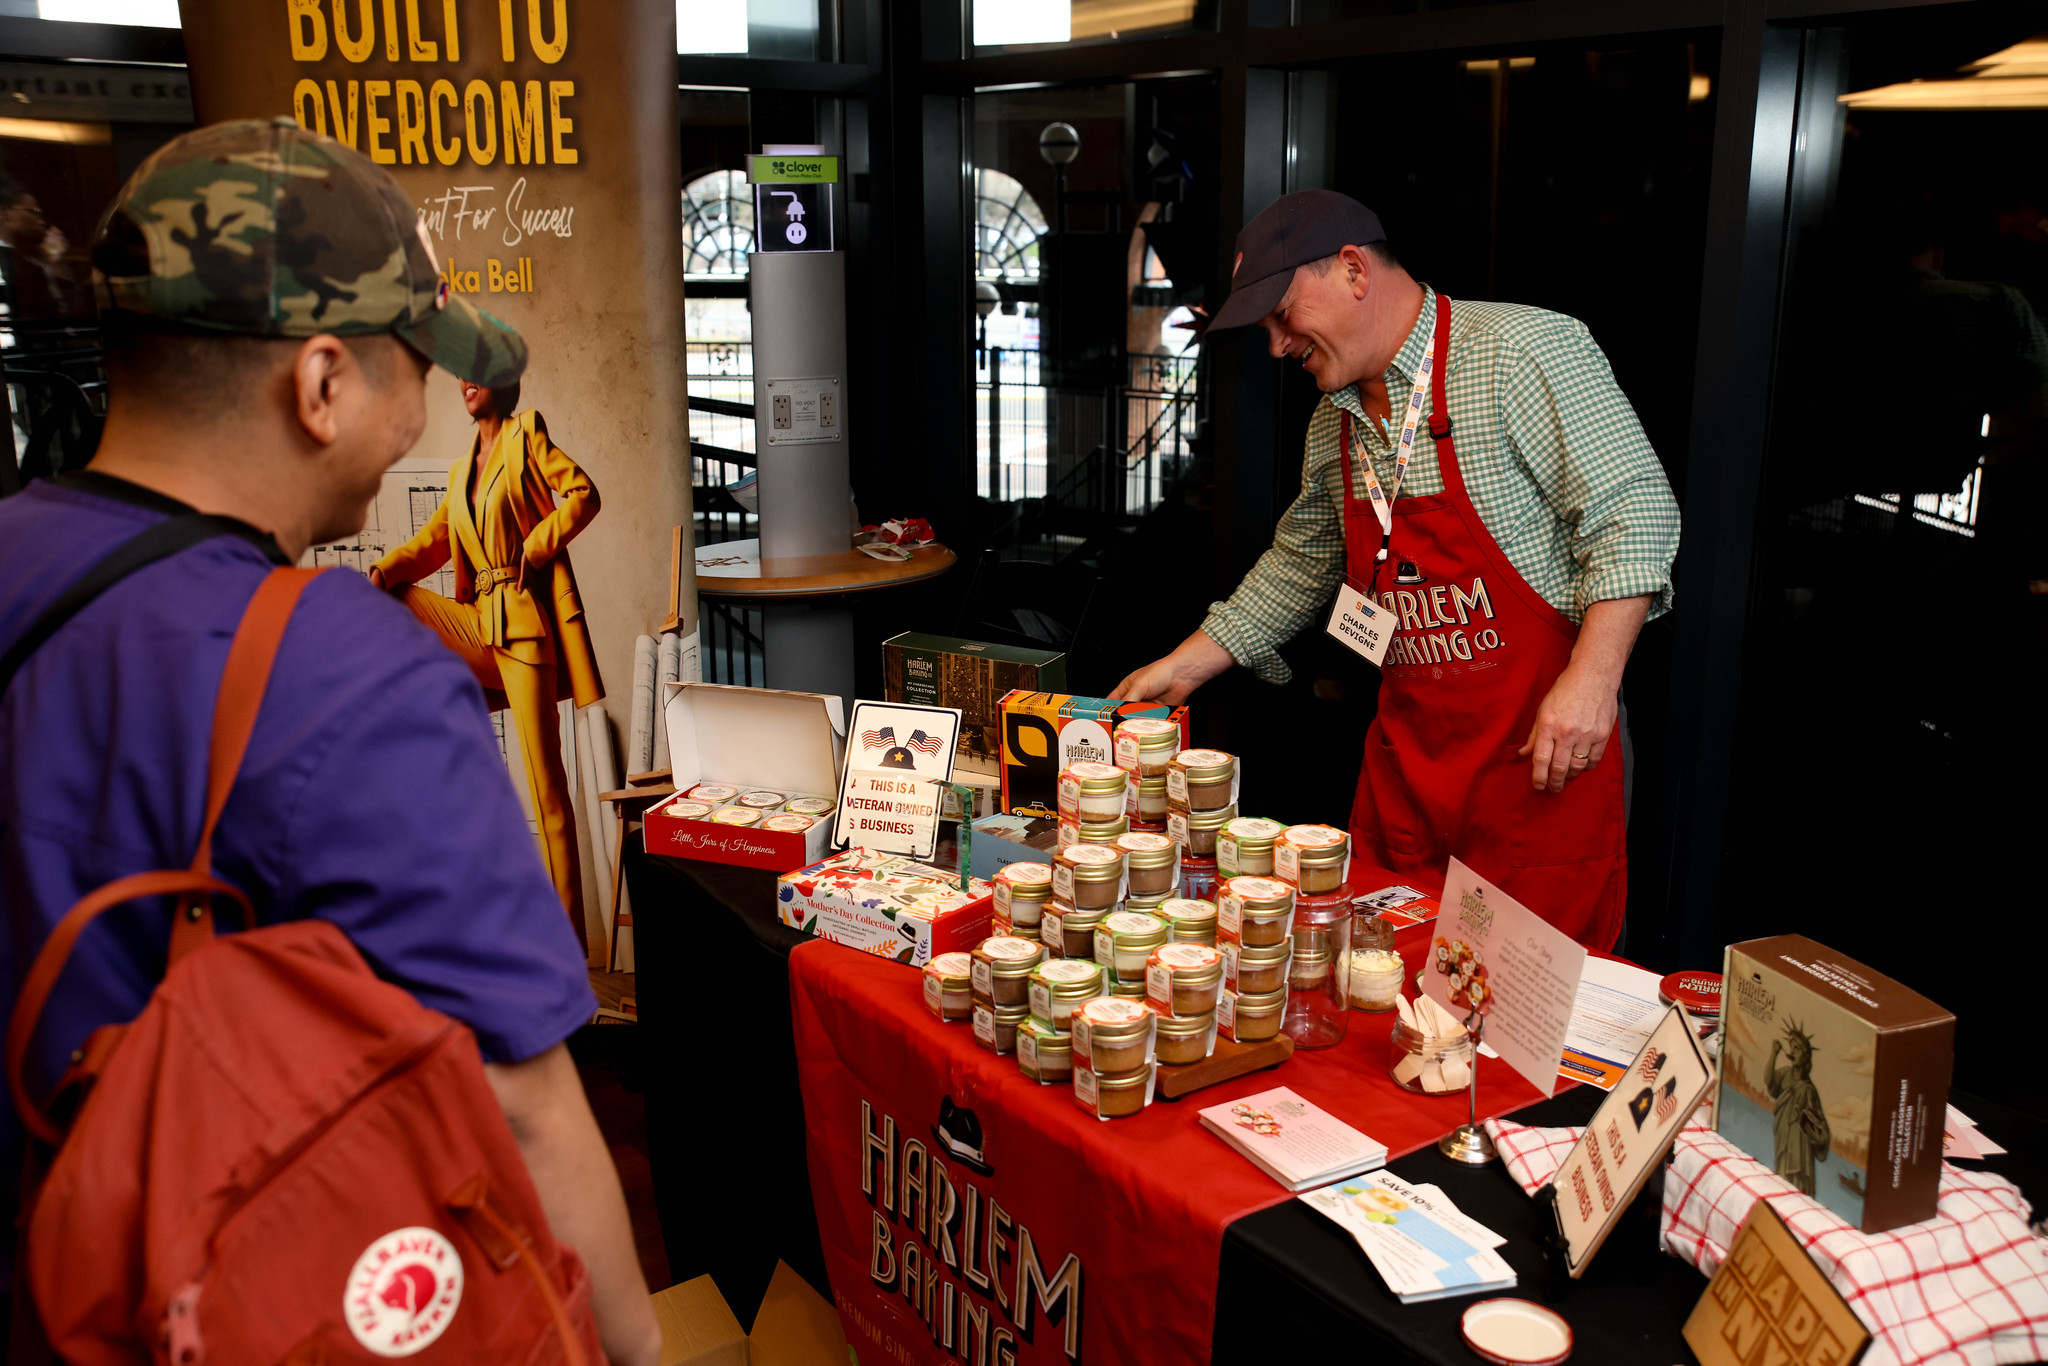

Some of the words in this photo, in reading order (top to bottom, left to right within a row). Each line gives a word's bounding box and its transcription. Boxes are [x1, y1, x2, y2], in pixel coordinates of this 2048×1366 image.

[287, 0, 460, 63] BUILT
[492, 0, 569, 64] TO
[293, 79, 578, 166] OVERCOME
[786, 161, 822, 172] clover
[453, 186, 496, 240] For
[503, 177, 574, 246] Success
[487, 257, 533, 293] Bell
[1338, 621, 1376, 651] DEVIGNE
[1342, 612, 1380, 642] CHARLES
[1473, 628, 1507, 651] CO.
[907, 659, 933, 672] HARLEM
[908, 668, 928, 679] BAKING
[906, 685, 937, 695] COLLECTION
[1066, 744, 1105, 761] HARLEM
[870, 779, 893, 793] THIS
[896, 782, 907, 794] IS
[908, 783, 916, 795] A
[846, 796, 893, 813] VETERAN
[895, 802, 933, 817] OWNED
[670, 829, 694, 846] Little
[692, 833, 717, 849] Jars
[719, 838, 728, 852] of
[728, 838, 776, 855] Happiness
[859, 818, 914, 836] BUSINESS
[806, 898, 838, 916] Mother's
[839, 907, 855, 923] Day
[855, 912, 895, 933] Collection
[1460, 888, 1494, 927] HARLEM
[1779, 954, 1831, 982] ASSORTMENT
[1810, 963, 1859, 990] COLLECTION
[1737, 976, 1776, 1012] HARLEM
[1828, 980, 1879, 1009] CHOCOLATE
[1897, 1079, 1909, 1136] ASSORTMENT
[1605, 1117, 1621, 1149] THIS
[1902, 1105, 1913, 1160] COLLECTION
[1613, 1141, 1625, 1160] IS
[1616, 1153, 1627, 1170] A
[1892, 1137, 1903, 1189] CHOCOLATE
[1584, 1125, 1604, 1176] VETERAN
[1596, 1167, 1615, 1213] OWNED
[1377, 1177, 1413, 1198] SAVE
[1410, 1194, 1436, 1212] 10%
[1571, 1164, 1594, 1222] BUSINESS
[861, 1098, 1081, 1360] HARLEM
[870, 1209, 1016, 1366] BAKING
[1712, 1265, 1743, 1315] IN
[836, 1289, 882, 1346] PREMIUM
